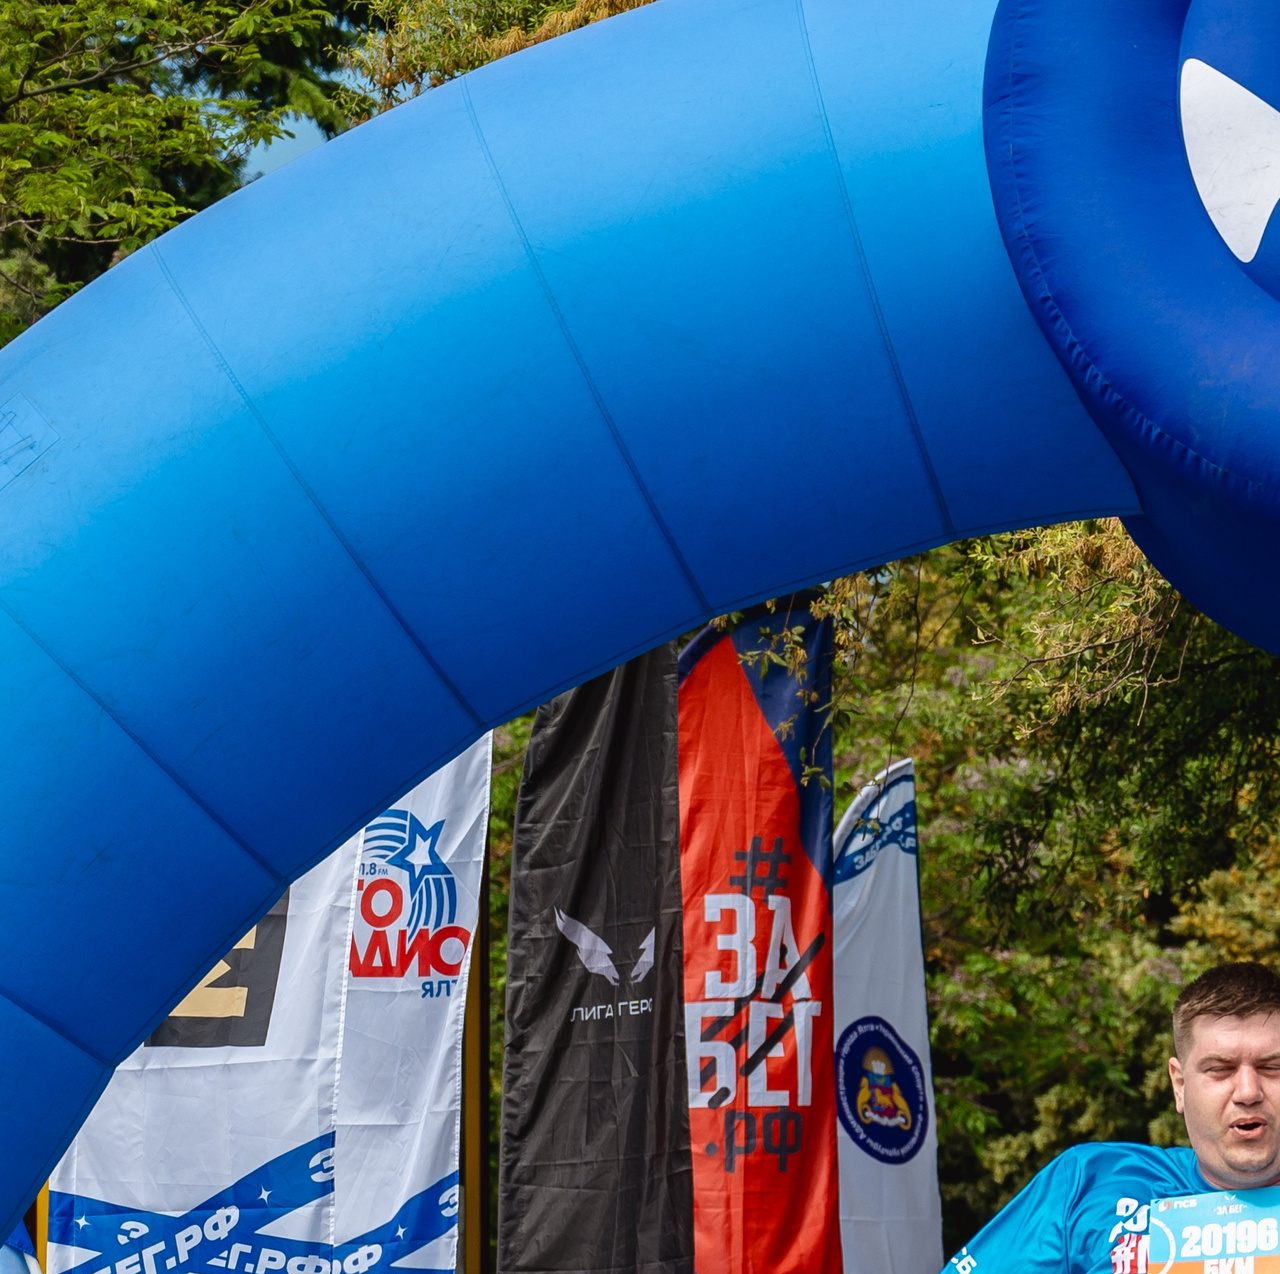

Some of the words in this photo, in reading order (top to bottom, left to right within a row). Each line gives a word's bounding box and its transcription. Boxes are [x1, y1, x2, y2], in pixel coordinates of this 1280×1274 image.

[359, 862, 377, 876] 1.8
[570, 1003, 614, 1023] ЛИГА
[1180, 1217, 1280, 1258] 20196
